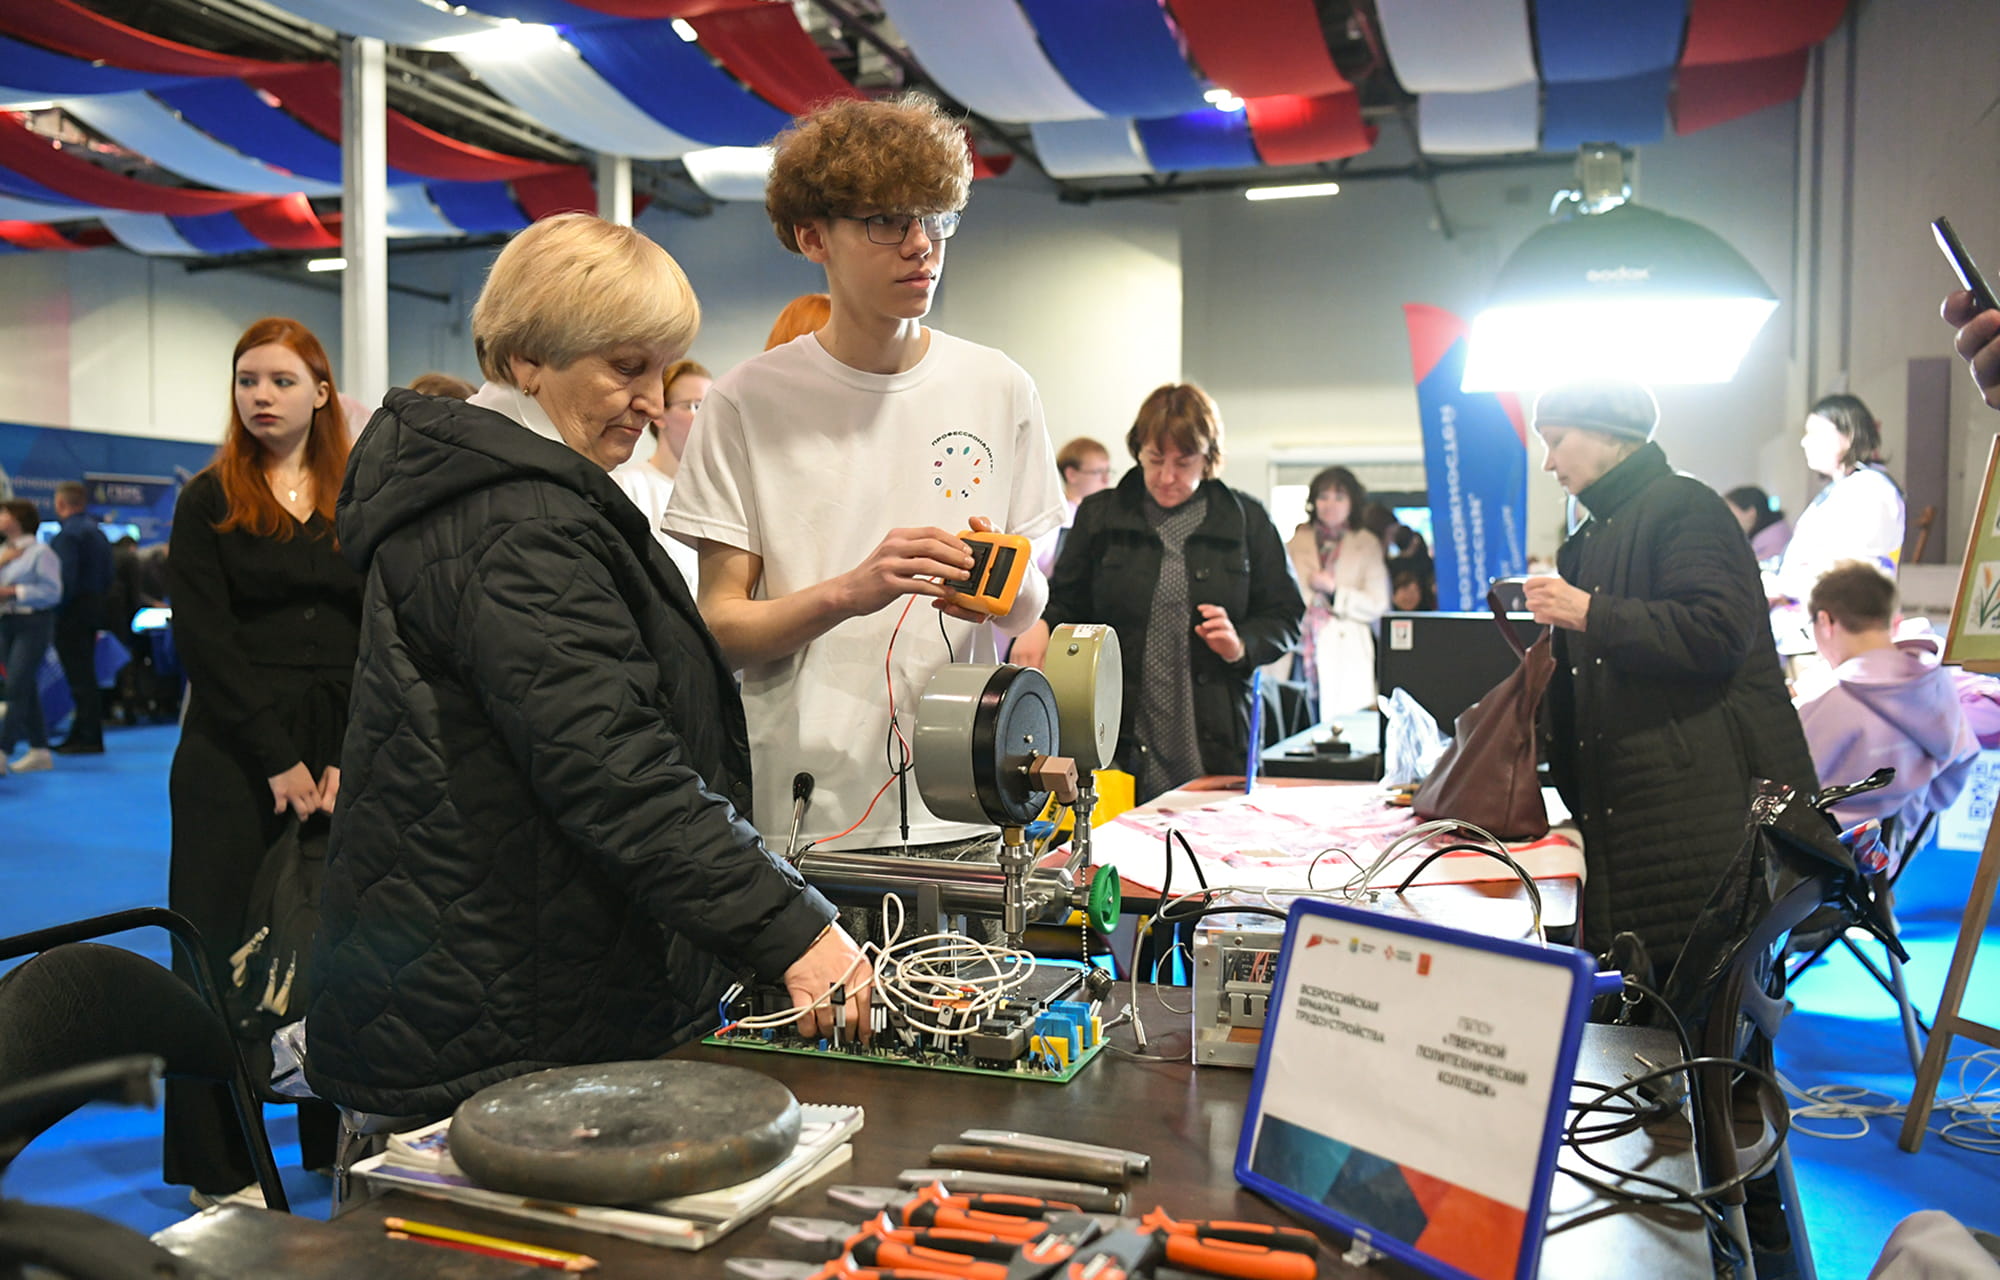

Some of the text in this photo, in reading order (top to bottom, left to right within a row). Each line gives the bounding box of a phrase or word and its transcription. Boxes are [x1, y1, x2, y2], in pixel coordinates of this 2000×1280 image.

[1298, 997, 1341, 1016] ЯРМАРКА
[1300, 984, 1380, 1012] ВСЕРОССИЙСКАЯ
[1295, 1009, 1385, 1042] ТРУДОУСТРОЙСТВА
